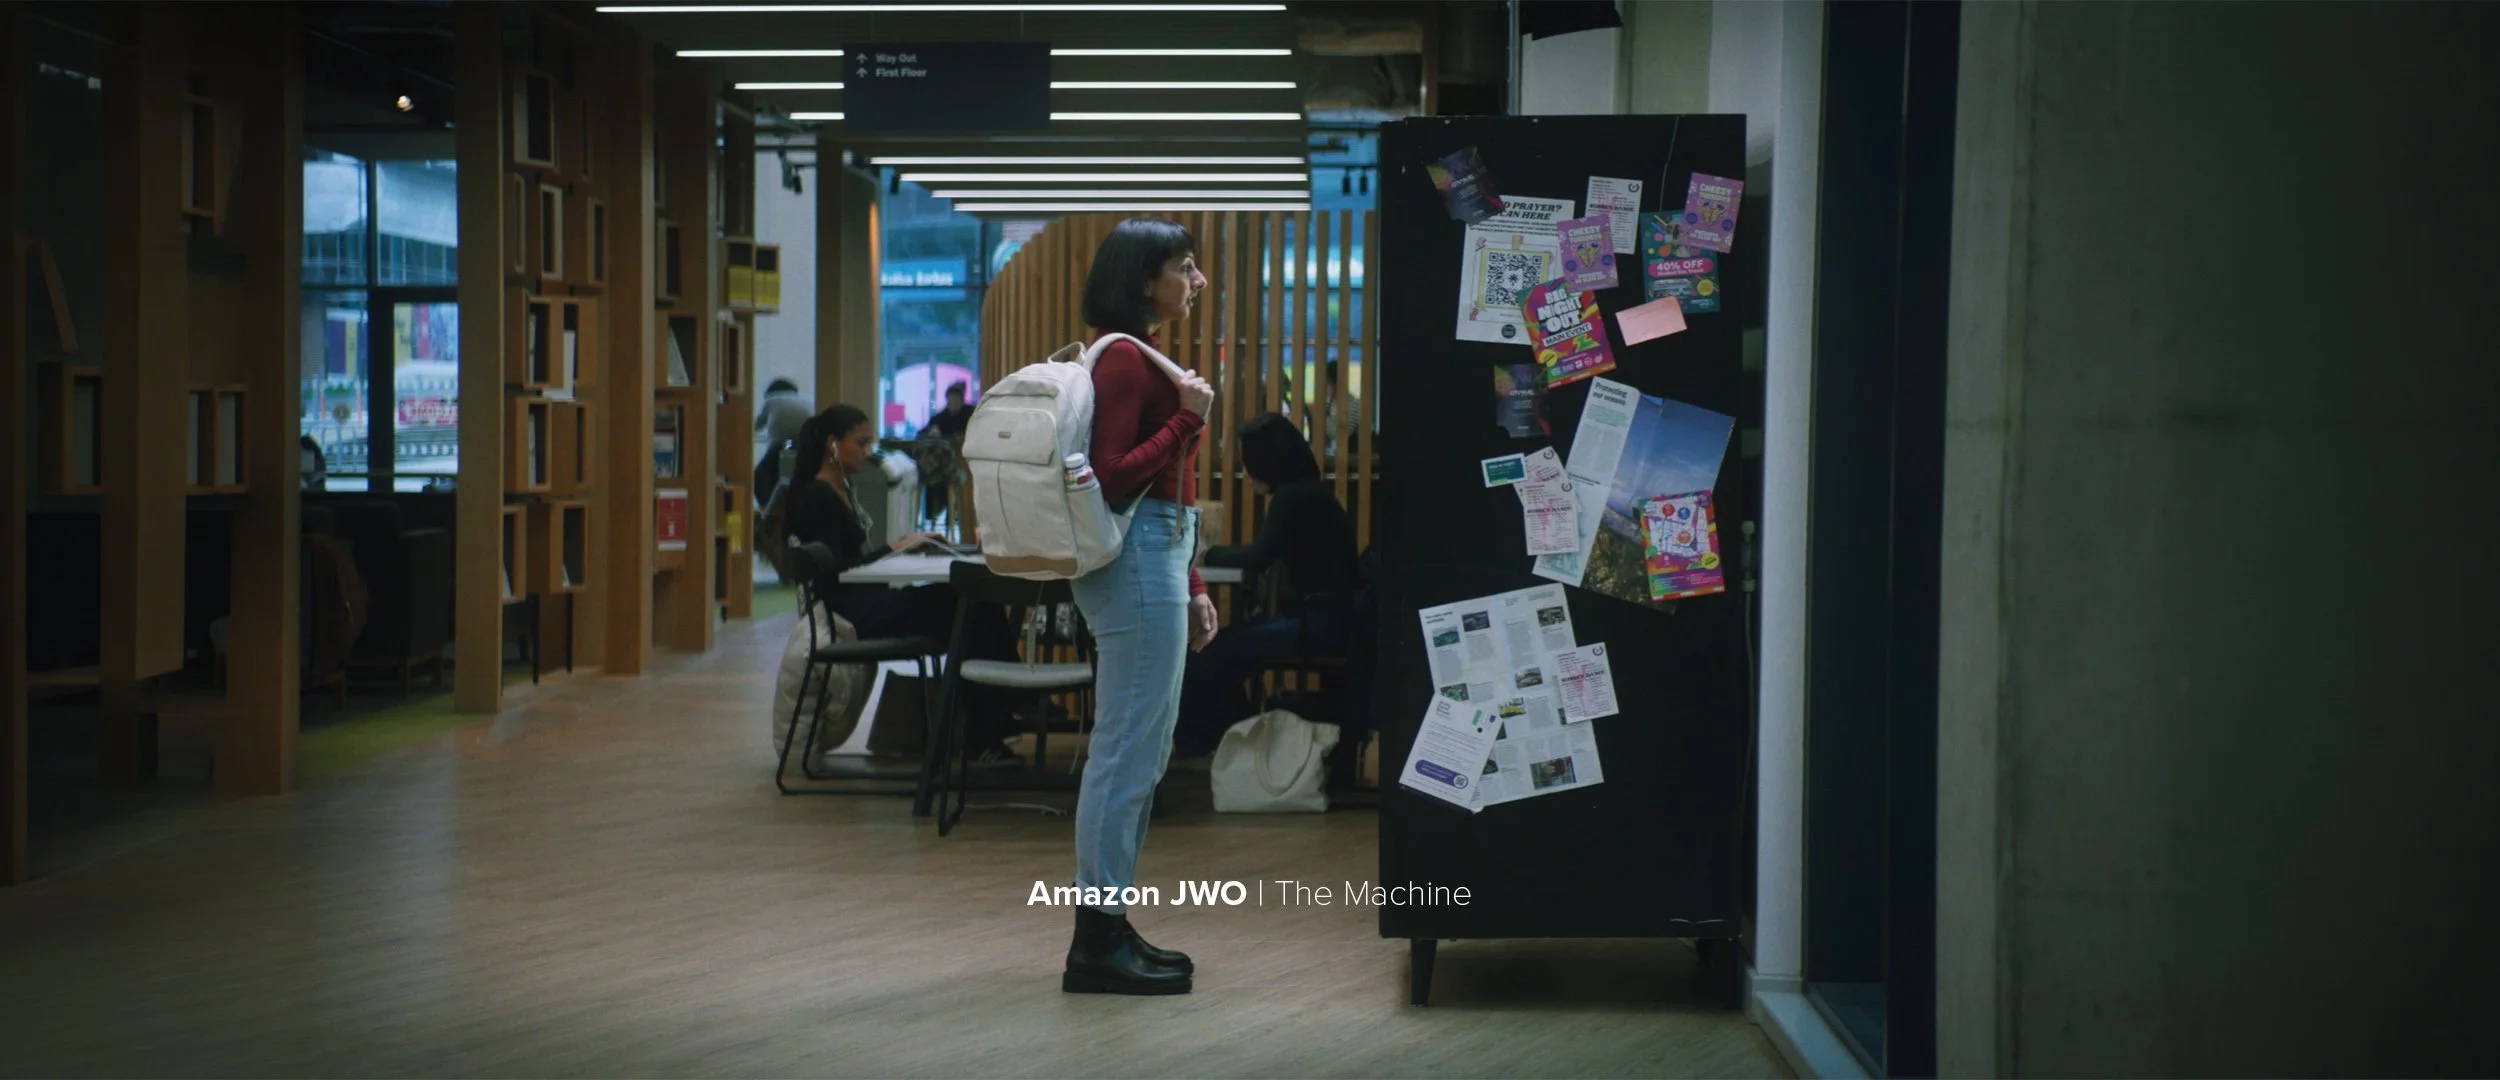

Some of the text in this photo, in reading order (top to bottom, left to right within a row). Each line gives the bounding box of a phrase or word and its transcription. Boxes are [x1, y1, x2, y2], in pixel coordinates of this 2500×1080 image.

[876, 54, 917, 65] Way Out
[876, 68, 927, 77] First Floor
[1700, 184, 1731, 196] CHEESY
[1509, 201, 1562, 212] PRAYER?
[1519, 211, 1551, 220] HERE
[1568, 225, 1601, 237] CHEESY
[1657, 260, 1704, 271] 40% OFF
[1545, 288, 1568, 304] BIG
[1537, 296, 1582, 321] NIGHT
[1546, 309, 1581, 333] OUT
[1545, 323, 1590, 344] MAIN EVENT
[1595, 382, 1627, 399] Protecting
[1604, 395, 1625, 406] oceans
